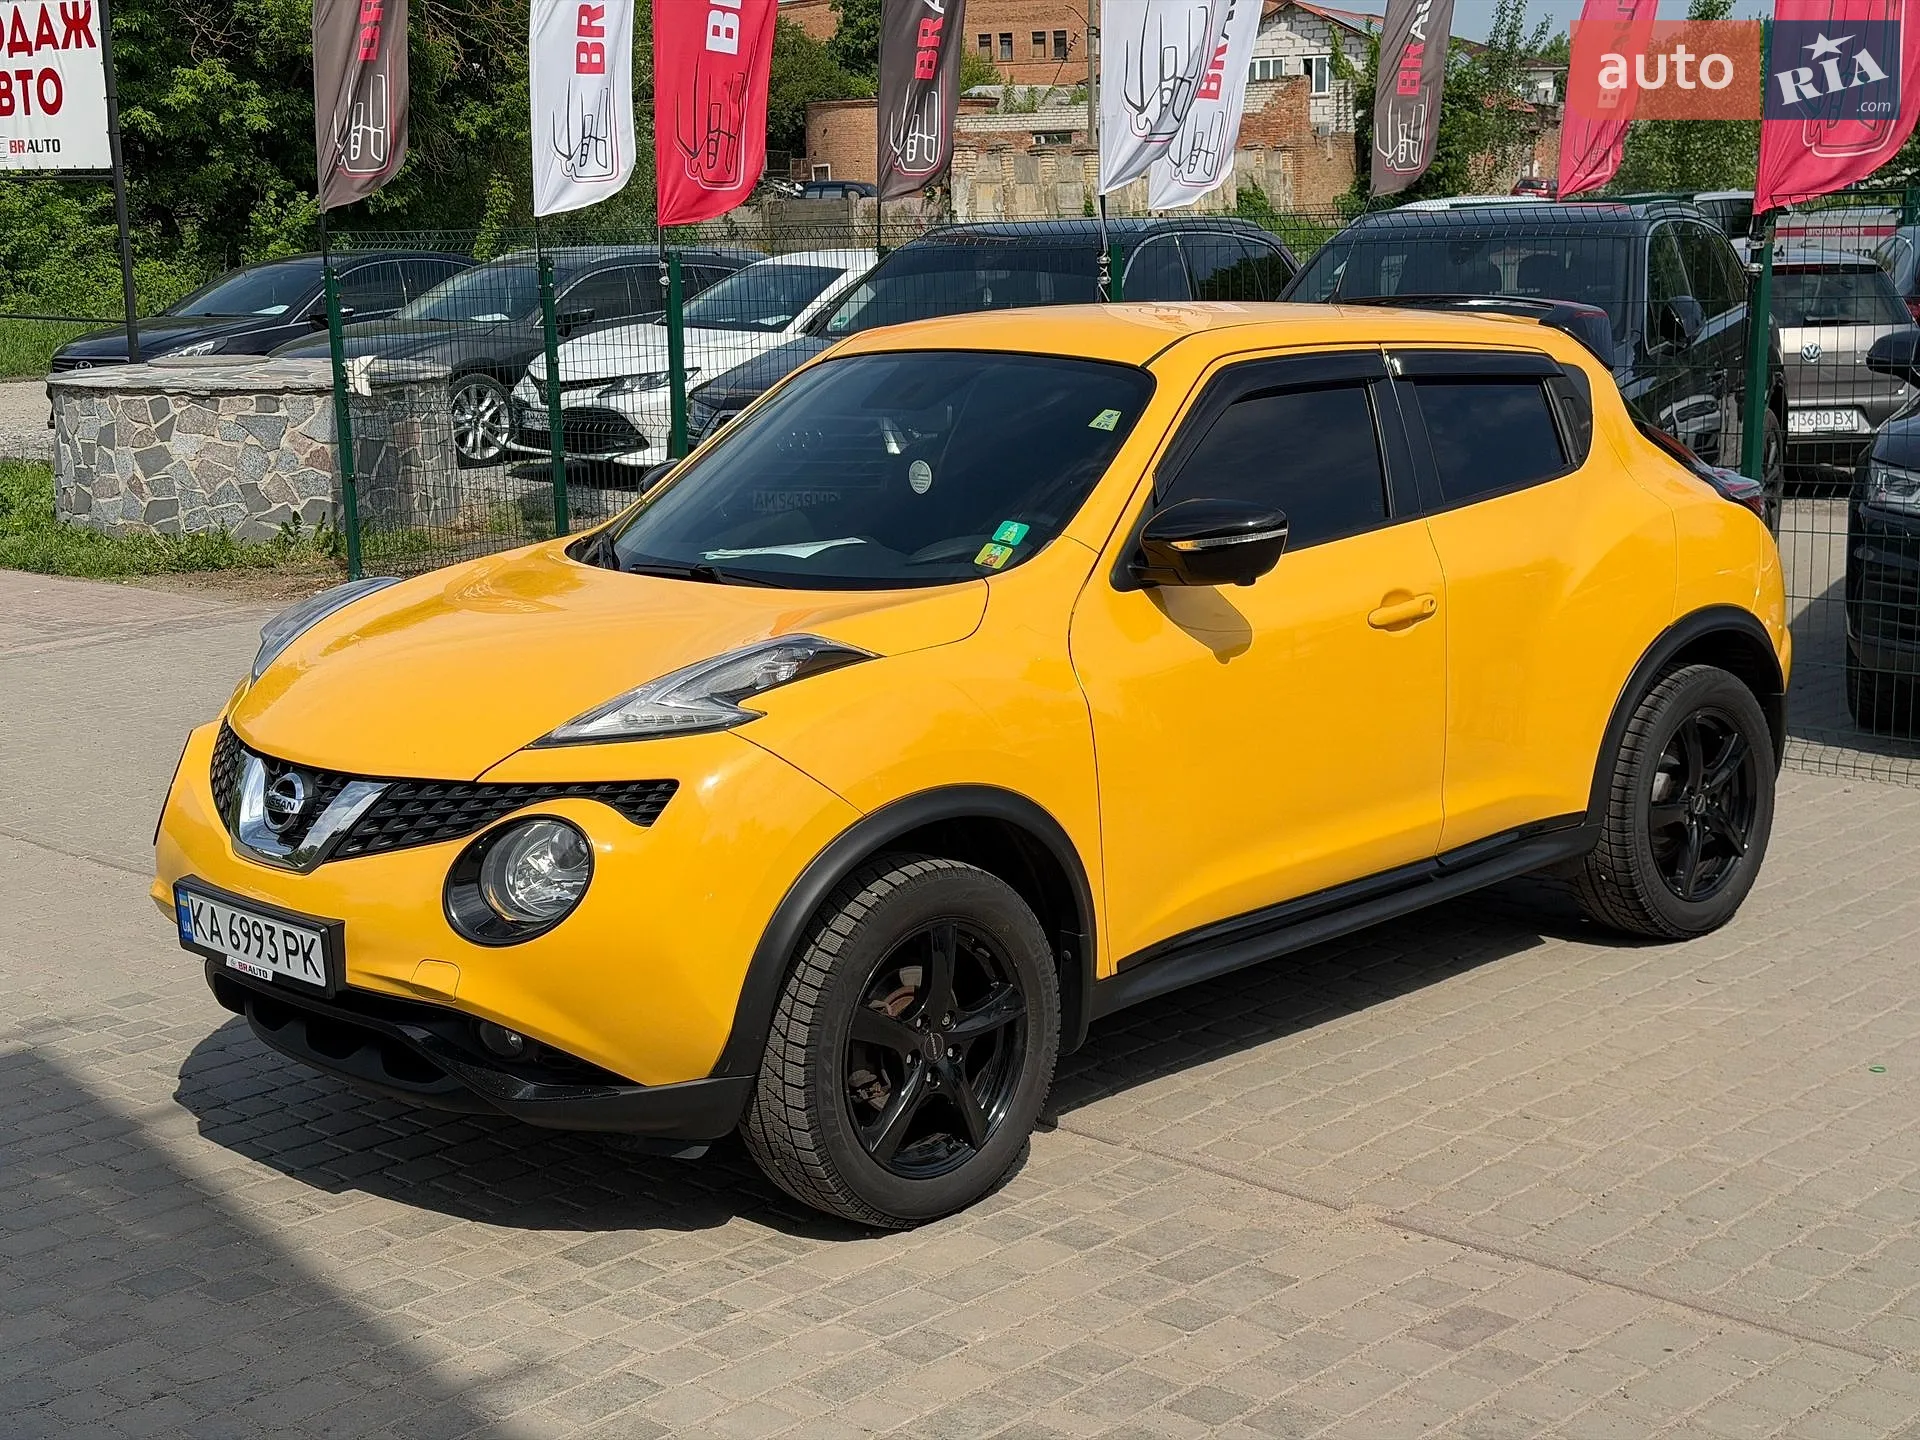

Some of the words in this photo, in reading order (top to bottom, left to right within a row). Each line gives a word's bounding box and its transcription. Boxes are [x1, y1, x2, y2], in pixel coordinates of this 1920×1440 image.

[0, 0, 97, 59] ДАЖ
[705, 0, 742, 56] B
[9, 138, 61, 154] BRAUTO
[181, 919, 193, 934] UA
[189, 897, 225, 948] KA
[228, 912, 279, 965] 6993
[282, 928, 322, 979] PK
[237, 960, 268, 979] BRAUTO
